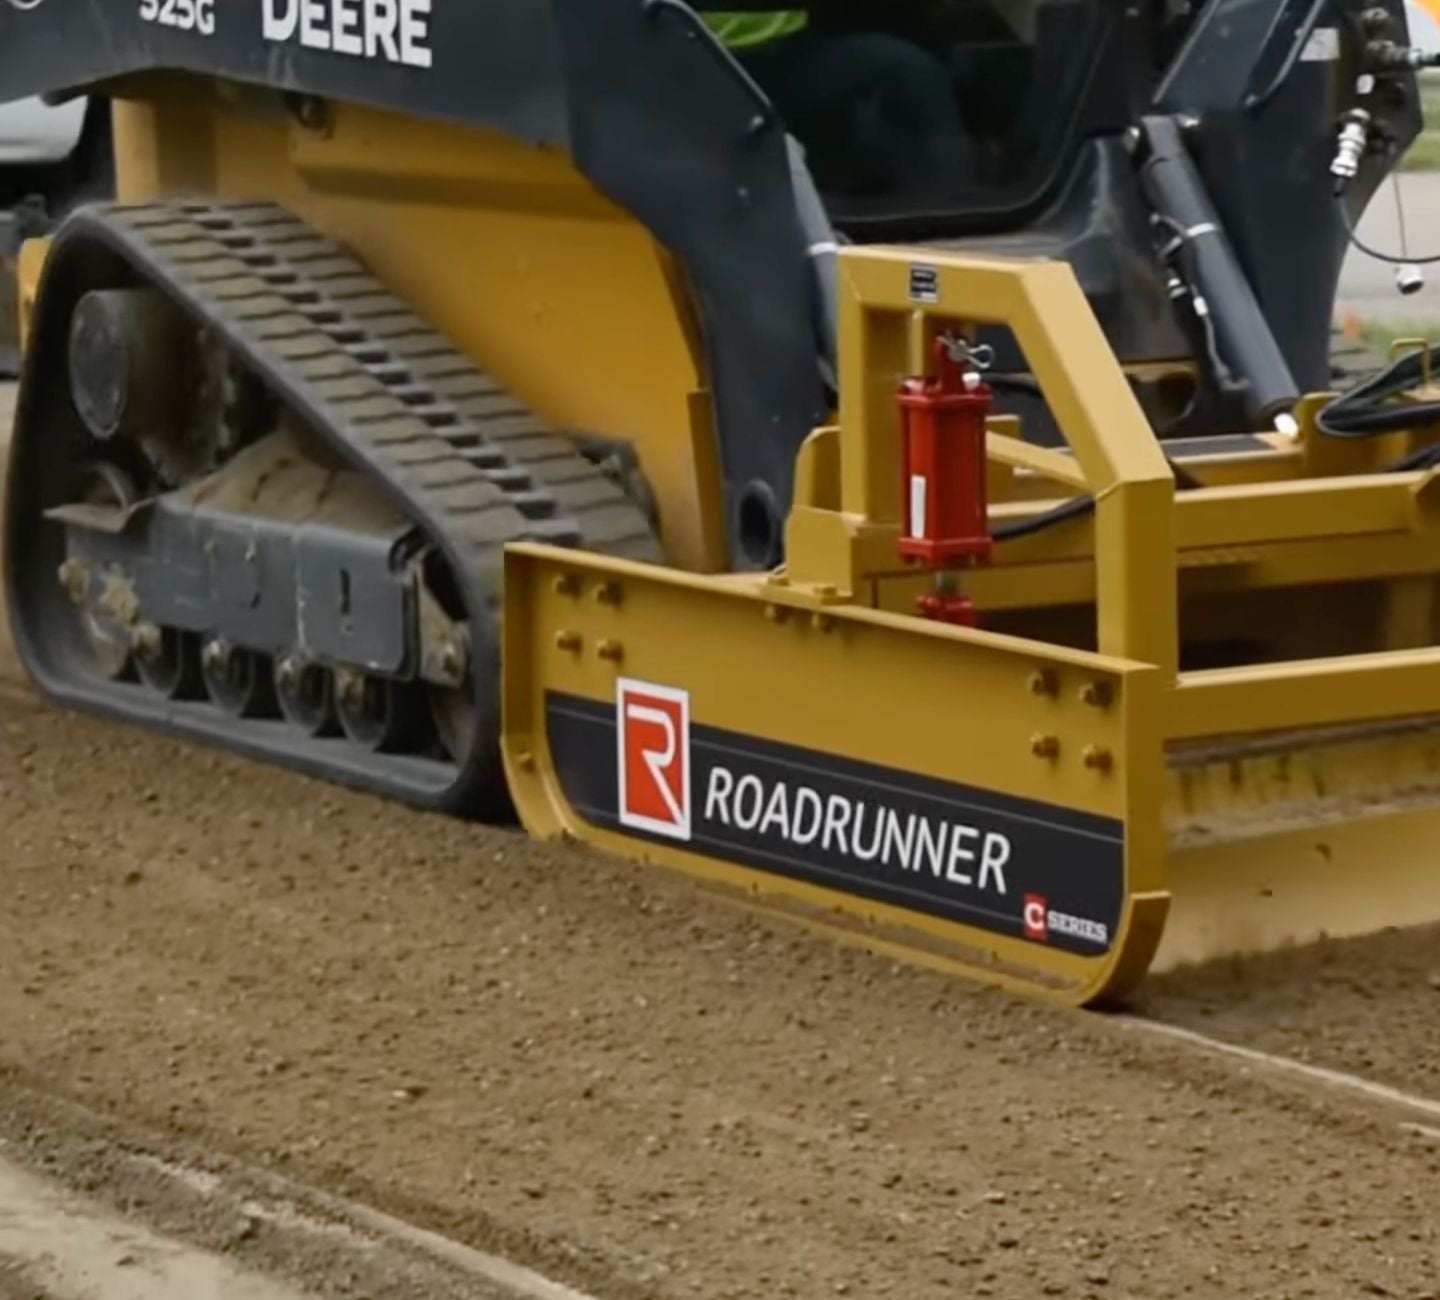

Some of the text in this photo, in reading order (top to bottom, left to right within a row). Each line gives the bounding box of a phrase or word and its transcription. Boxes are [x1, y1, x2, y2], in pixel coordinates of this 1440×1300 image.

[262, 0, 432, 67] DEERE
[704, 766, 1011, 894] ROADRUNNER
[1024, 902, 1108, 944] C SERIES
